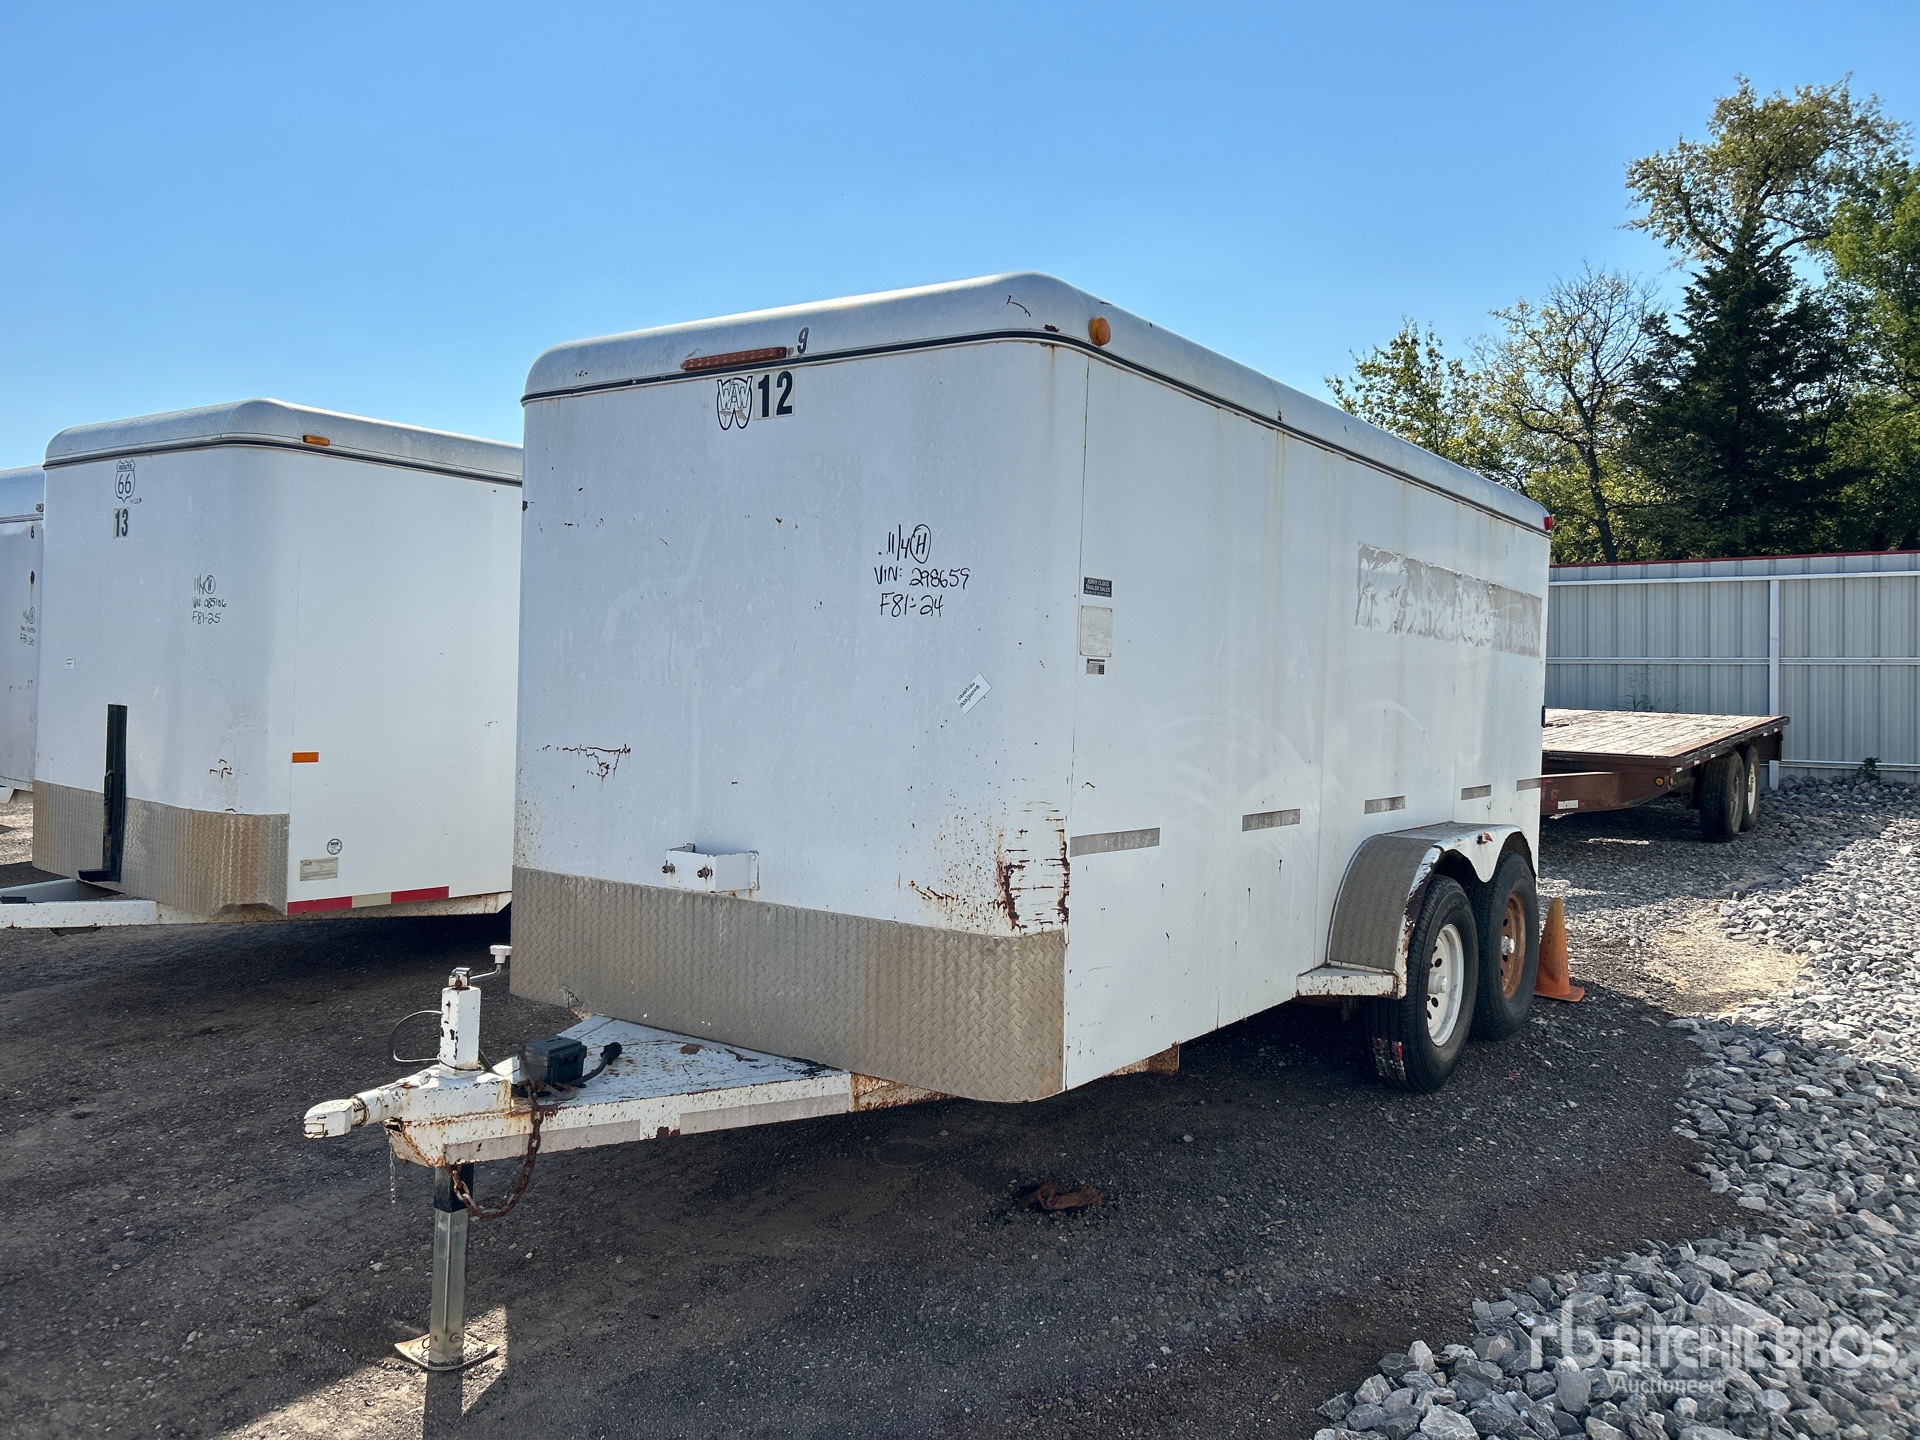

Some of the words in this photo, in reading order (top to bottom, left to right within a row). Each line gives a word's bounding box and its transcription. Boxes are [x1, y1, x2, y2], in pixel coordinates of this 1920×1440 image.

[797, 327, 809, 354] 9
[758, 370, 793, 418] 12
[118, 473, 132, 494] 66
[115, 508, 129, 538] 13
